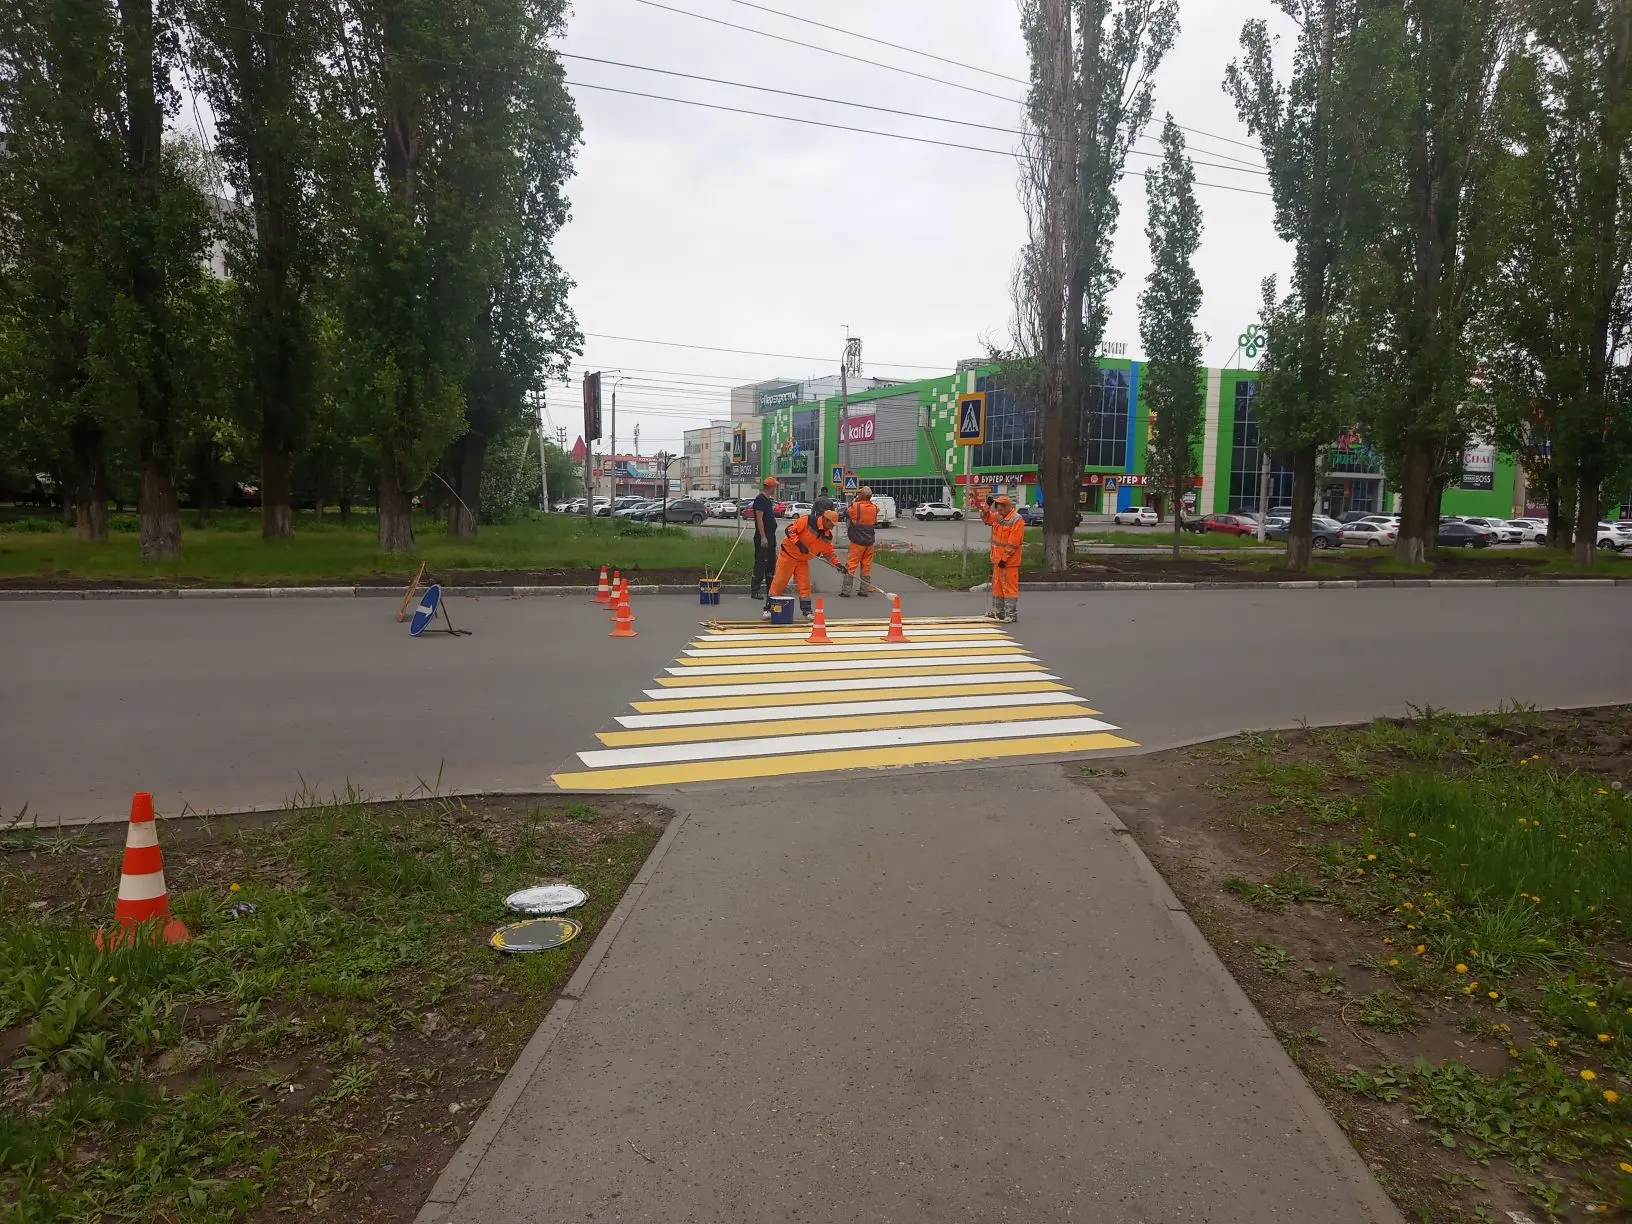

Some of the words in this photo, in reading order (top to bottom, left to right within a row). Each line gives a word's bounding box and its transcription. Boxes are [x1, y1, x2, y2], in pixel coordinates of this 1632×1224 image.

[848, 424, 864, 440] kari
[981, 475, 1004, 484] БУРГЕР
[1475, 475, 1491, 483] BOSS
[895, 494, 934, 502] ZARINA
